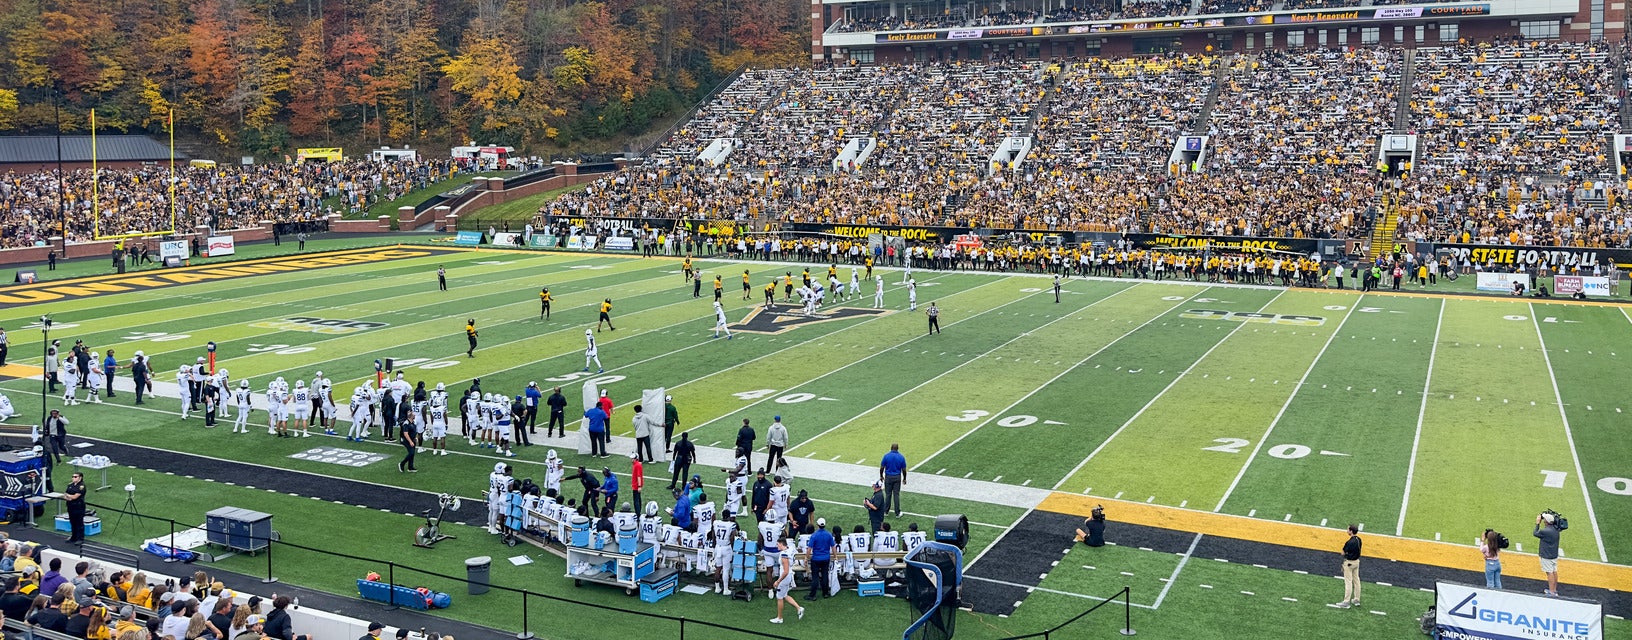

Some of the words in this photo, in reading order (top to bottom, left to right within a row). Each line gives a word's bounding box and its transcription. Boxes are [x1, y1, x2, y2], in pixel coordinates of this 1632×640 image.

[1430, 6, 1483, 14] COURTYARD
[1291, 14, 1315, 23] Newly
[1317, 11, 1358, 21] Renovated
[887, 33, 905, 41] Newly
[906, 32, 937, 40] Renovated
[834, 226, 880, 238] WELCOME
[900, 228, 927, 240] ROCK
[164, 241, 184, 250] UNC
[1241, 240, 1278, 253] ROCK
[1471, 248, 1515, 263] STATE
[1516, 249, 1597, 266] FOOTBALL
[731, 388, 817, 404] 40
[432, 412, 442, 420] 28
[945, 409, 1039, 428] 30
[1200, 437, 1312, 459] 20
[1539, 469, 1632, 496] 10
[702, 510, 712, 522] 33
[643, 524, 654, 534] 48
[716, 529, 727, 540] 47
[766, 531, 773, 542] 8
[856, 537, 865, 548] 19
[884, 536, 896, 548] 40
[1479, 608, 1589, 635] GRANITE
